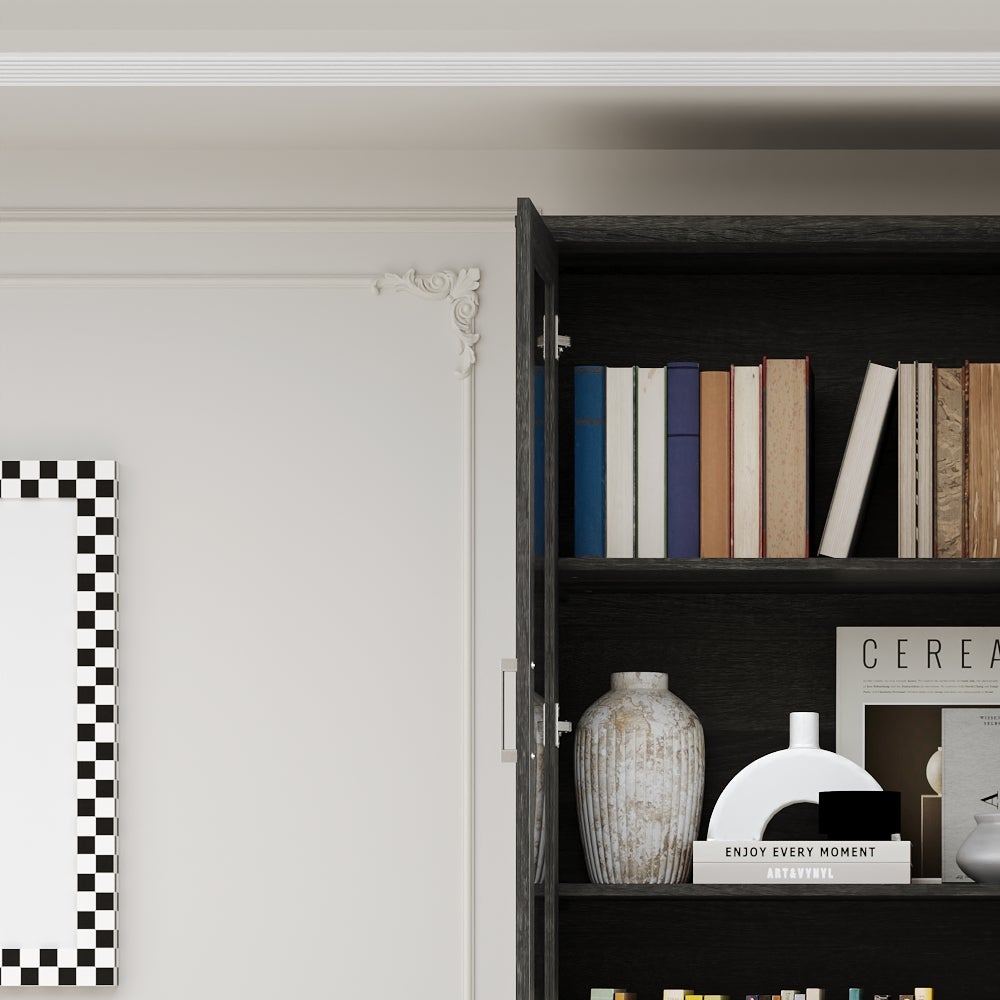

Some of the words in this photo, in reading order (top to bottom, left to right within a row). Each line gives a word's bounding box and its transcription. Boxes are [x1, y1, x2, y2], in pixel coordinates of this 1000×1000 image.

[726, 847, 766, 857] ENJOY
[773, 847, 814, 857] EVERY
[820, 847, 876, 857] MOMENT
[767, 868, 834, 879] ART&VYNYL
